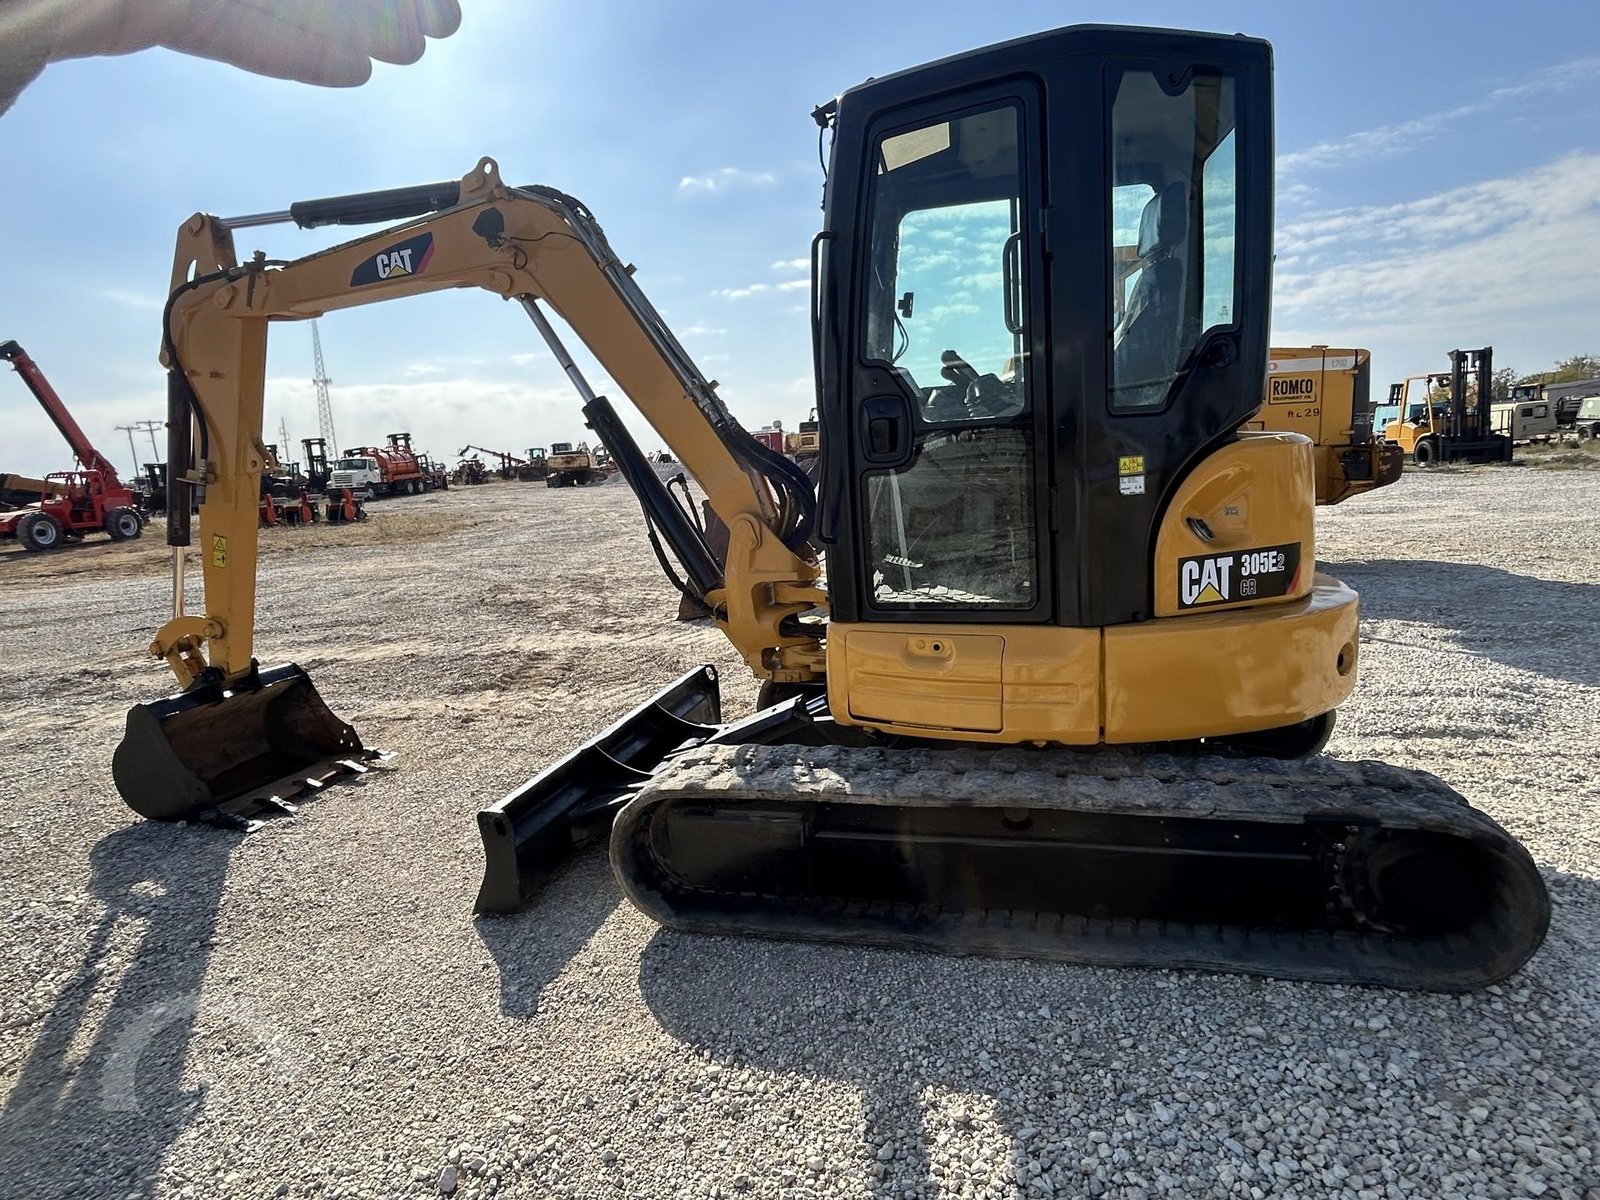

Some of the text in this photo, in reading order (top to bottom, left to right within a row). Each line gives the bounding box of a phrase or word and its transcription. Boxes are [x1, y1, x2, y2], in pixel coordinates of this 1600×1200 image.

[376, 248, 413, 279] CAT
[1273, 379, 1313, 395] ROMCO
[1182, 550, 1285, 605] CAT 305E2
[1240, 578, 1257, 595] CR
